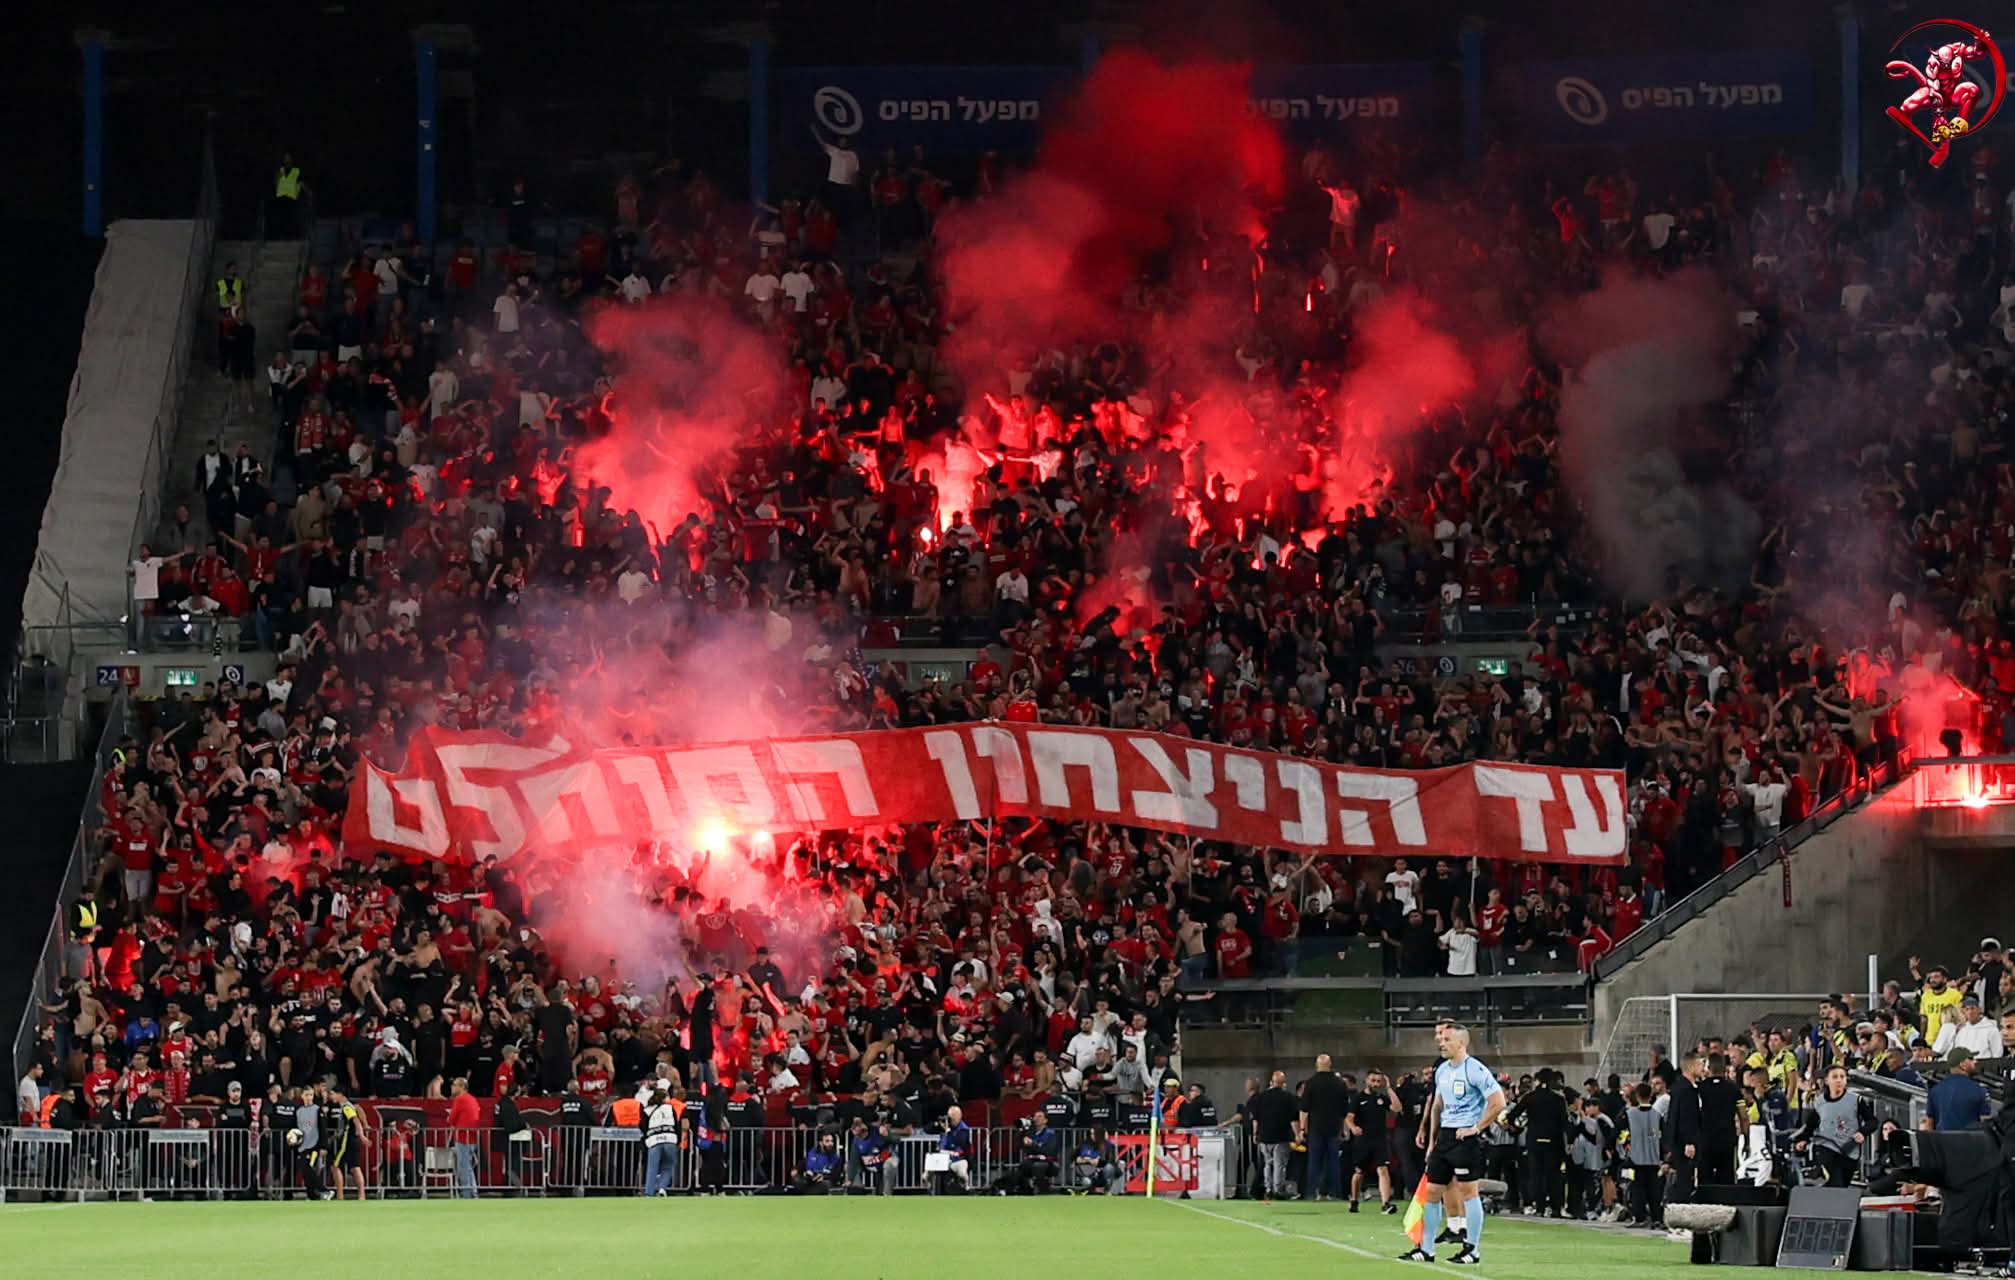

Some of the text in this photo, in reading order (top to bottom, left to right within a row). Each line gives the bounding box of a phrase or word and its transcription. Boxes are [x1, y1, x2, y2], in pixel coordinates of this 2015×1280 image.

[879, 96, 1040, 123] מפעל הפיס
[1241, 95, 1399, 121] מפעל הפי
[1621, 82, 1783, 110] מפעל הפיס
[100, 670, 118, 682] 24
[925, 727, 1428, 847] הניצחון
[1473, 763, 1625, 857] עד
